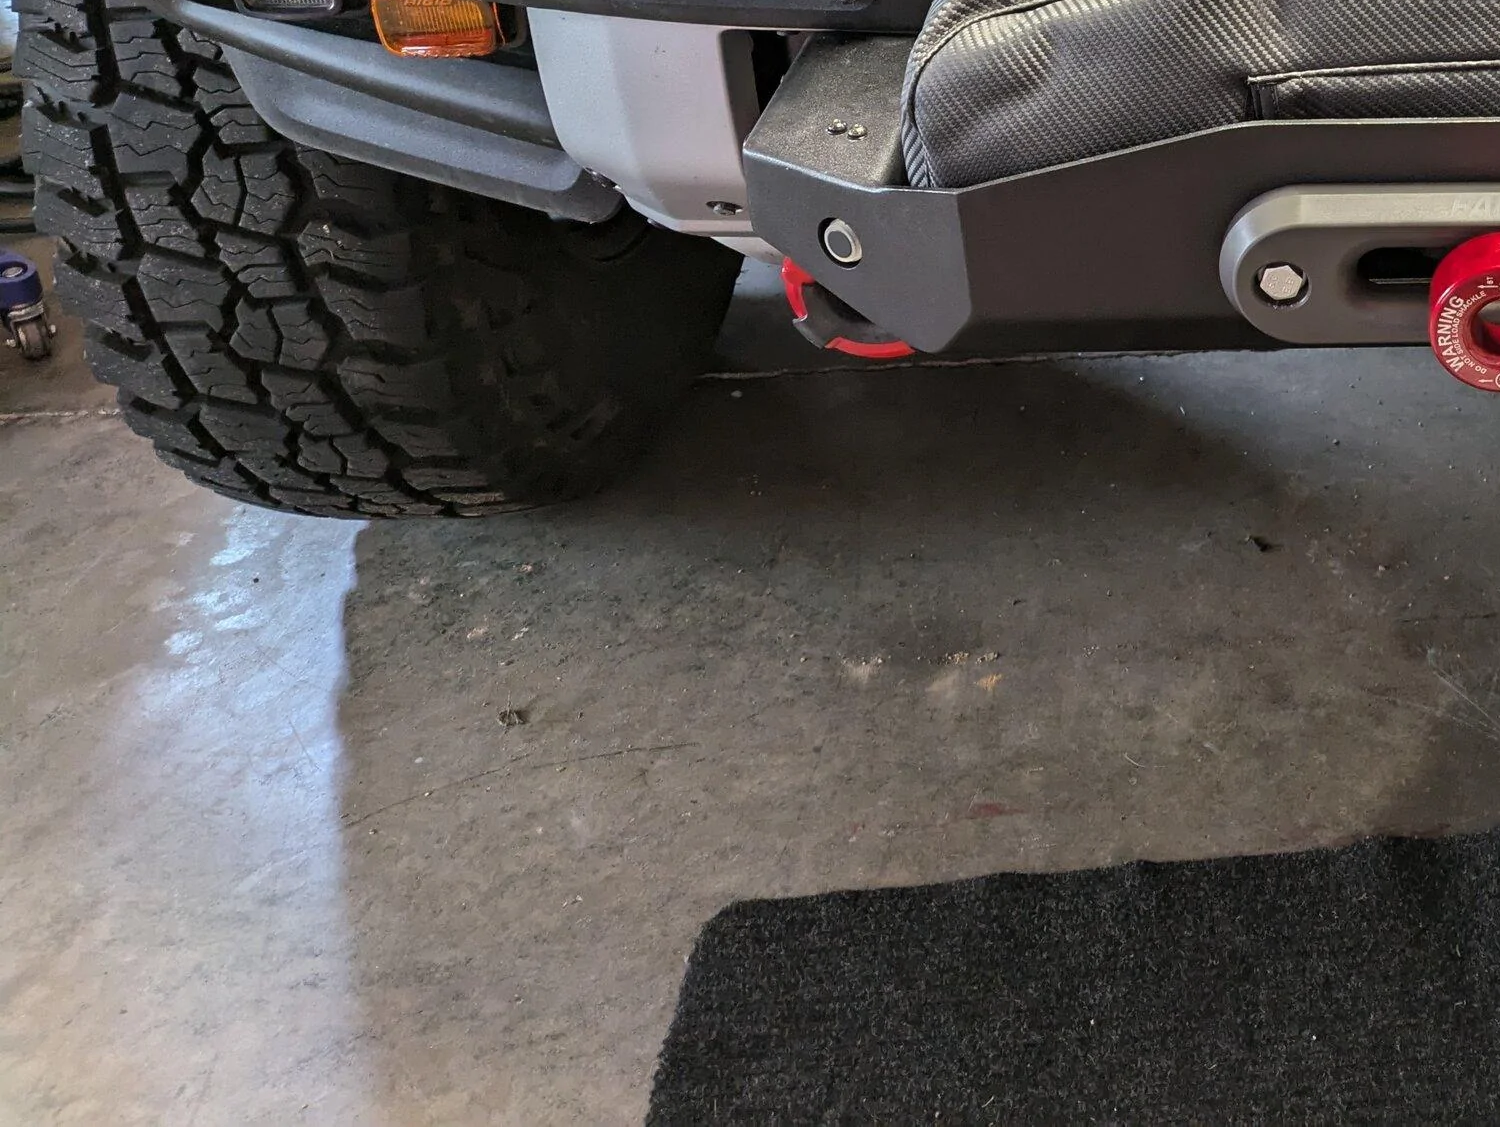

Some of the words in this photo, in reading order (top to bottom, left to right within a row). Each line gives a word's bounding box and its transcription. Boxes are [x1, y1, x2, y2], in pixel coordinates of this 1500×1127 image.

[1456, 290, 1487, 318] SHACKLE
[1437, 295, 1464, 373] WARNING
[1451, 317, 1460, 338] LOAD
[1452, 339, 1464, 355] SIDE
[1460, 354, 1477, 368] NOT
[1474, 363, 1488, 375] DO
